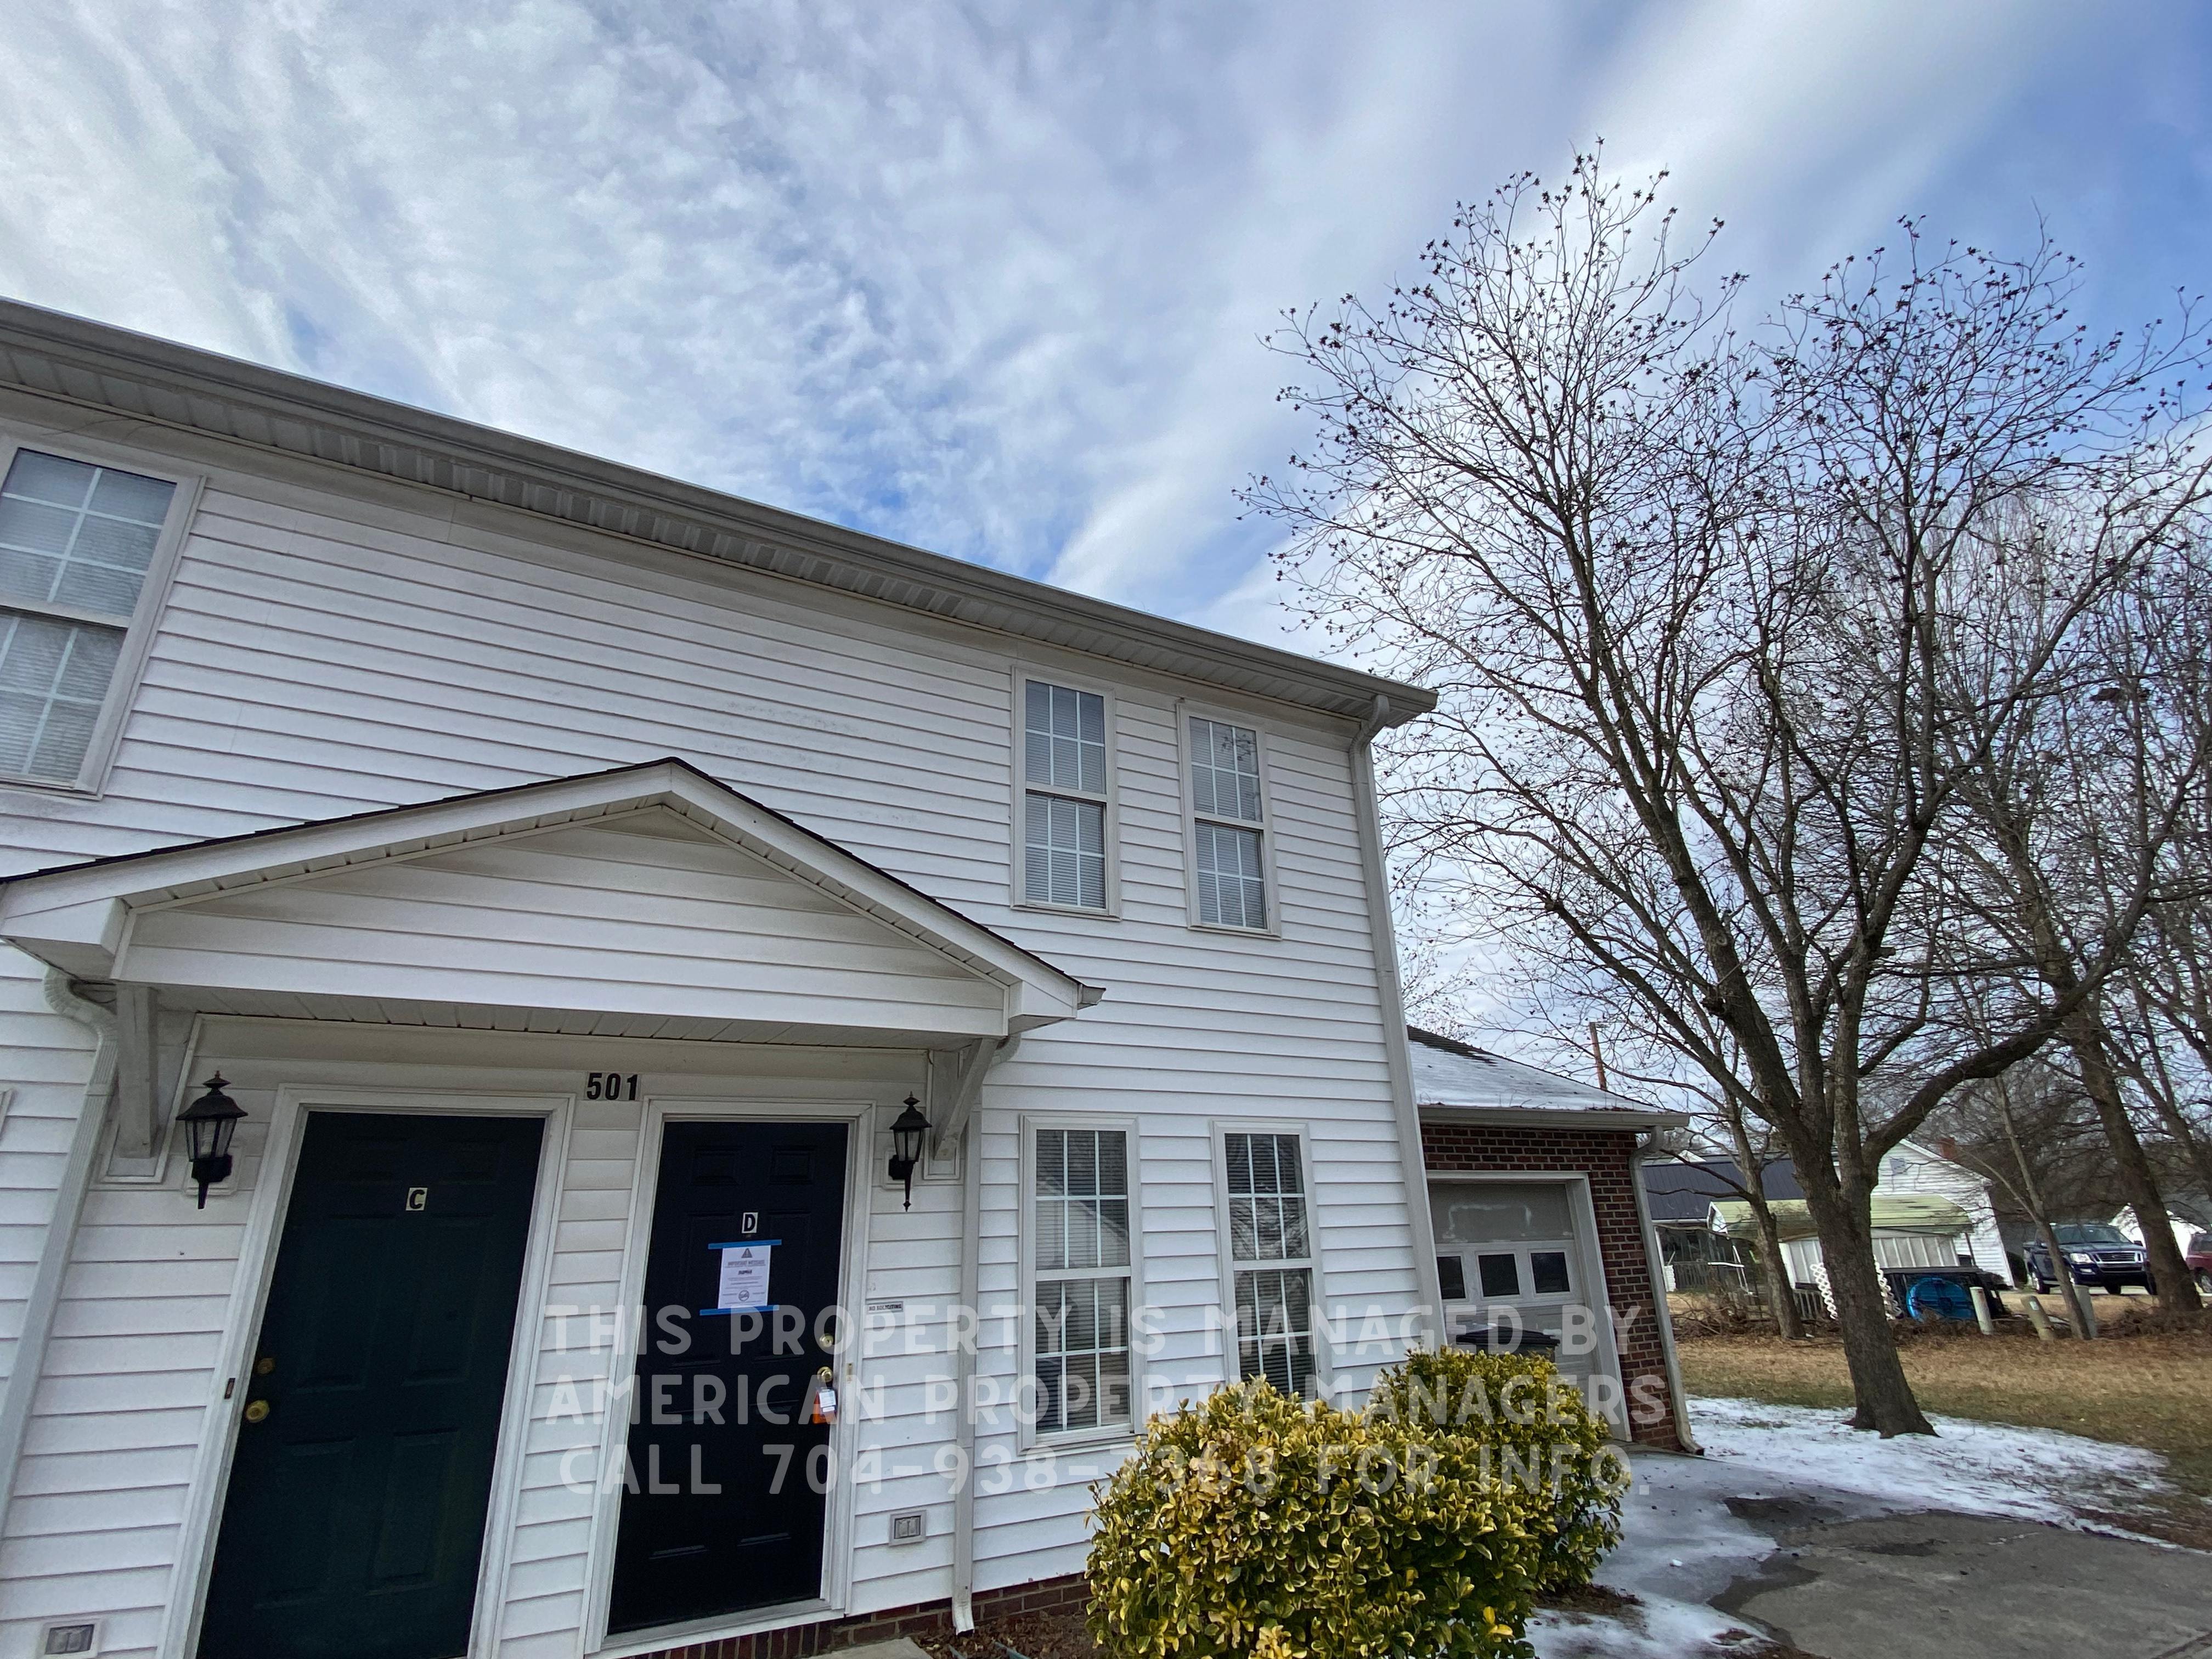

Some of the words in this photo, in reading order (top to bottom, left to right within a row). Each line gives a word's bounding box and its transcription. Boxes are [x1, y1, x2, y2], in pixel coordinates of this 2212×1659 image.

[587, 1073, 637, 1101] 501
[409, 1189, 425, 1209] C
[743, 1214, 756, 1232] D
